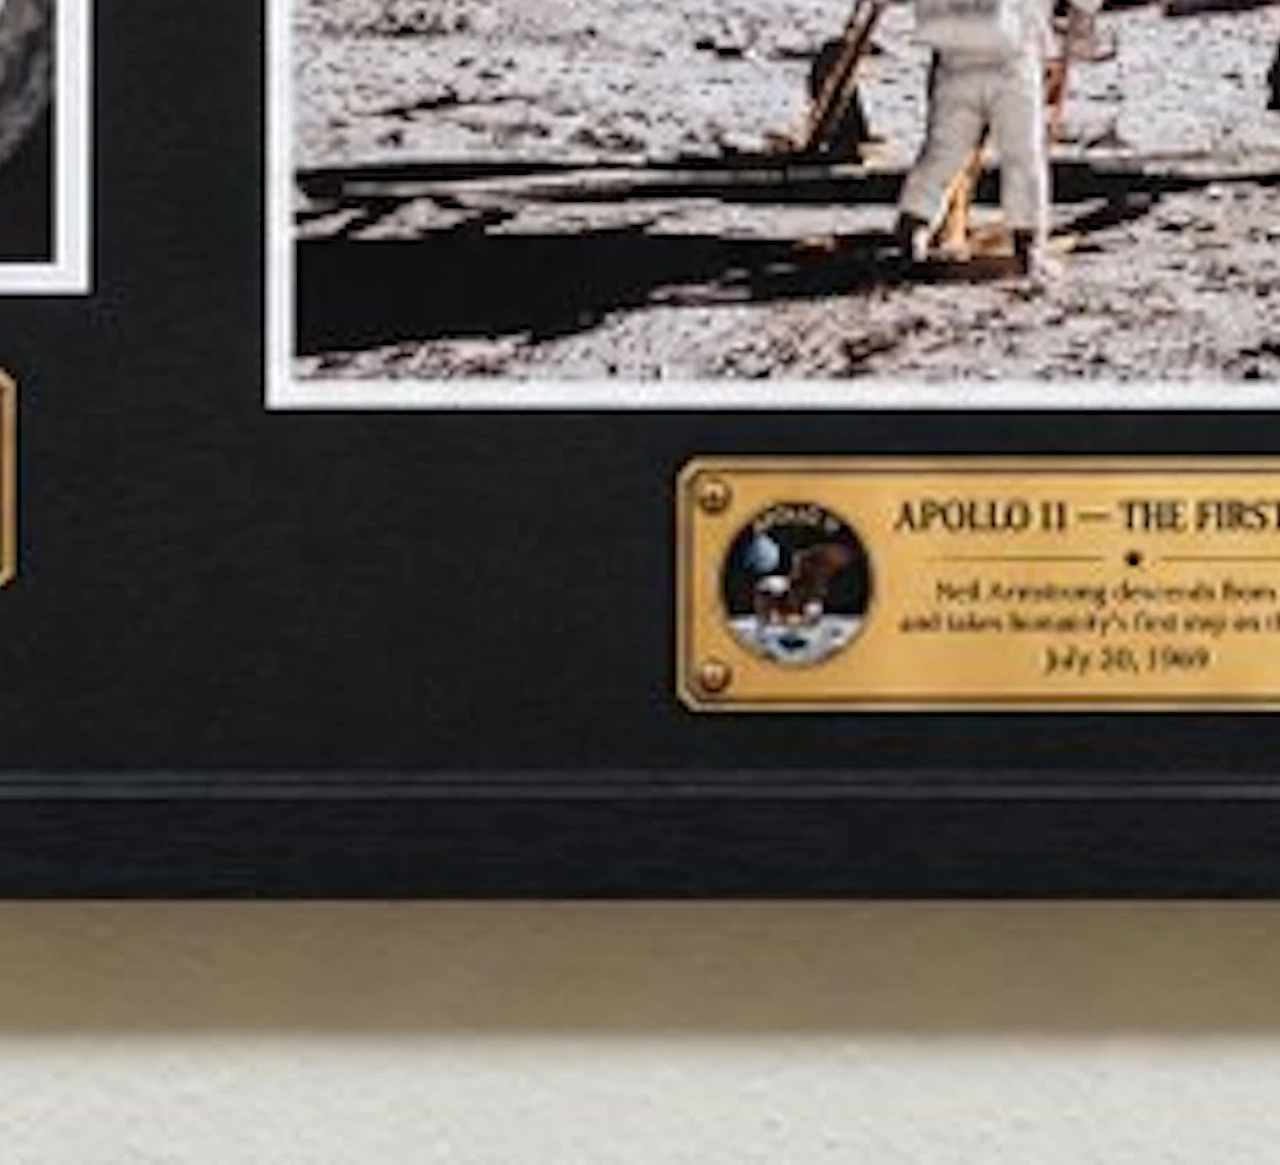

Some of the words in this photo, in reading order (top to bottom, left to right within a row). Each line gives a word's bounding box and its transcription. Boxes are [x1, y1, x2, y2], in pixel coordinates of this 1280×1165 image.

[893, 497, 1032, 532] APOLLO
[1118, 499, 1187, 532] THE
[934, 578, 981, 602] Neil
[987, 580, 1107, 609] Armstrong
[1221, 579, 1277, 602] from
[899, 612, 942, 633] and
[1043, 646, 1093, 676] July
[1100, 646, 1140, 674] 20,
[1147, 646, 1211, 671] 1969
